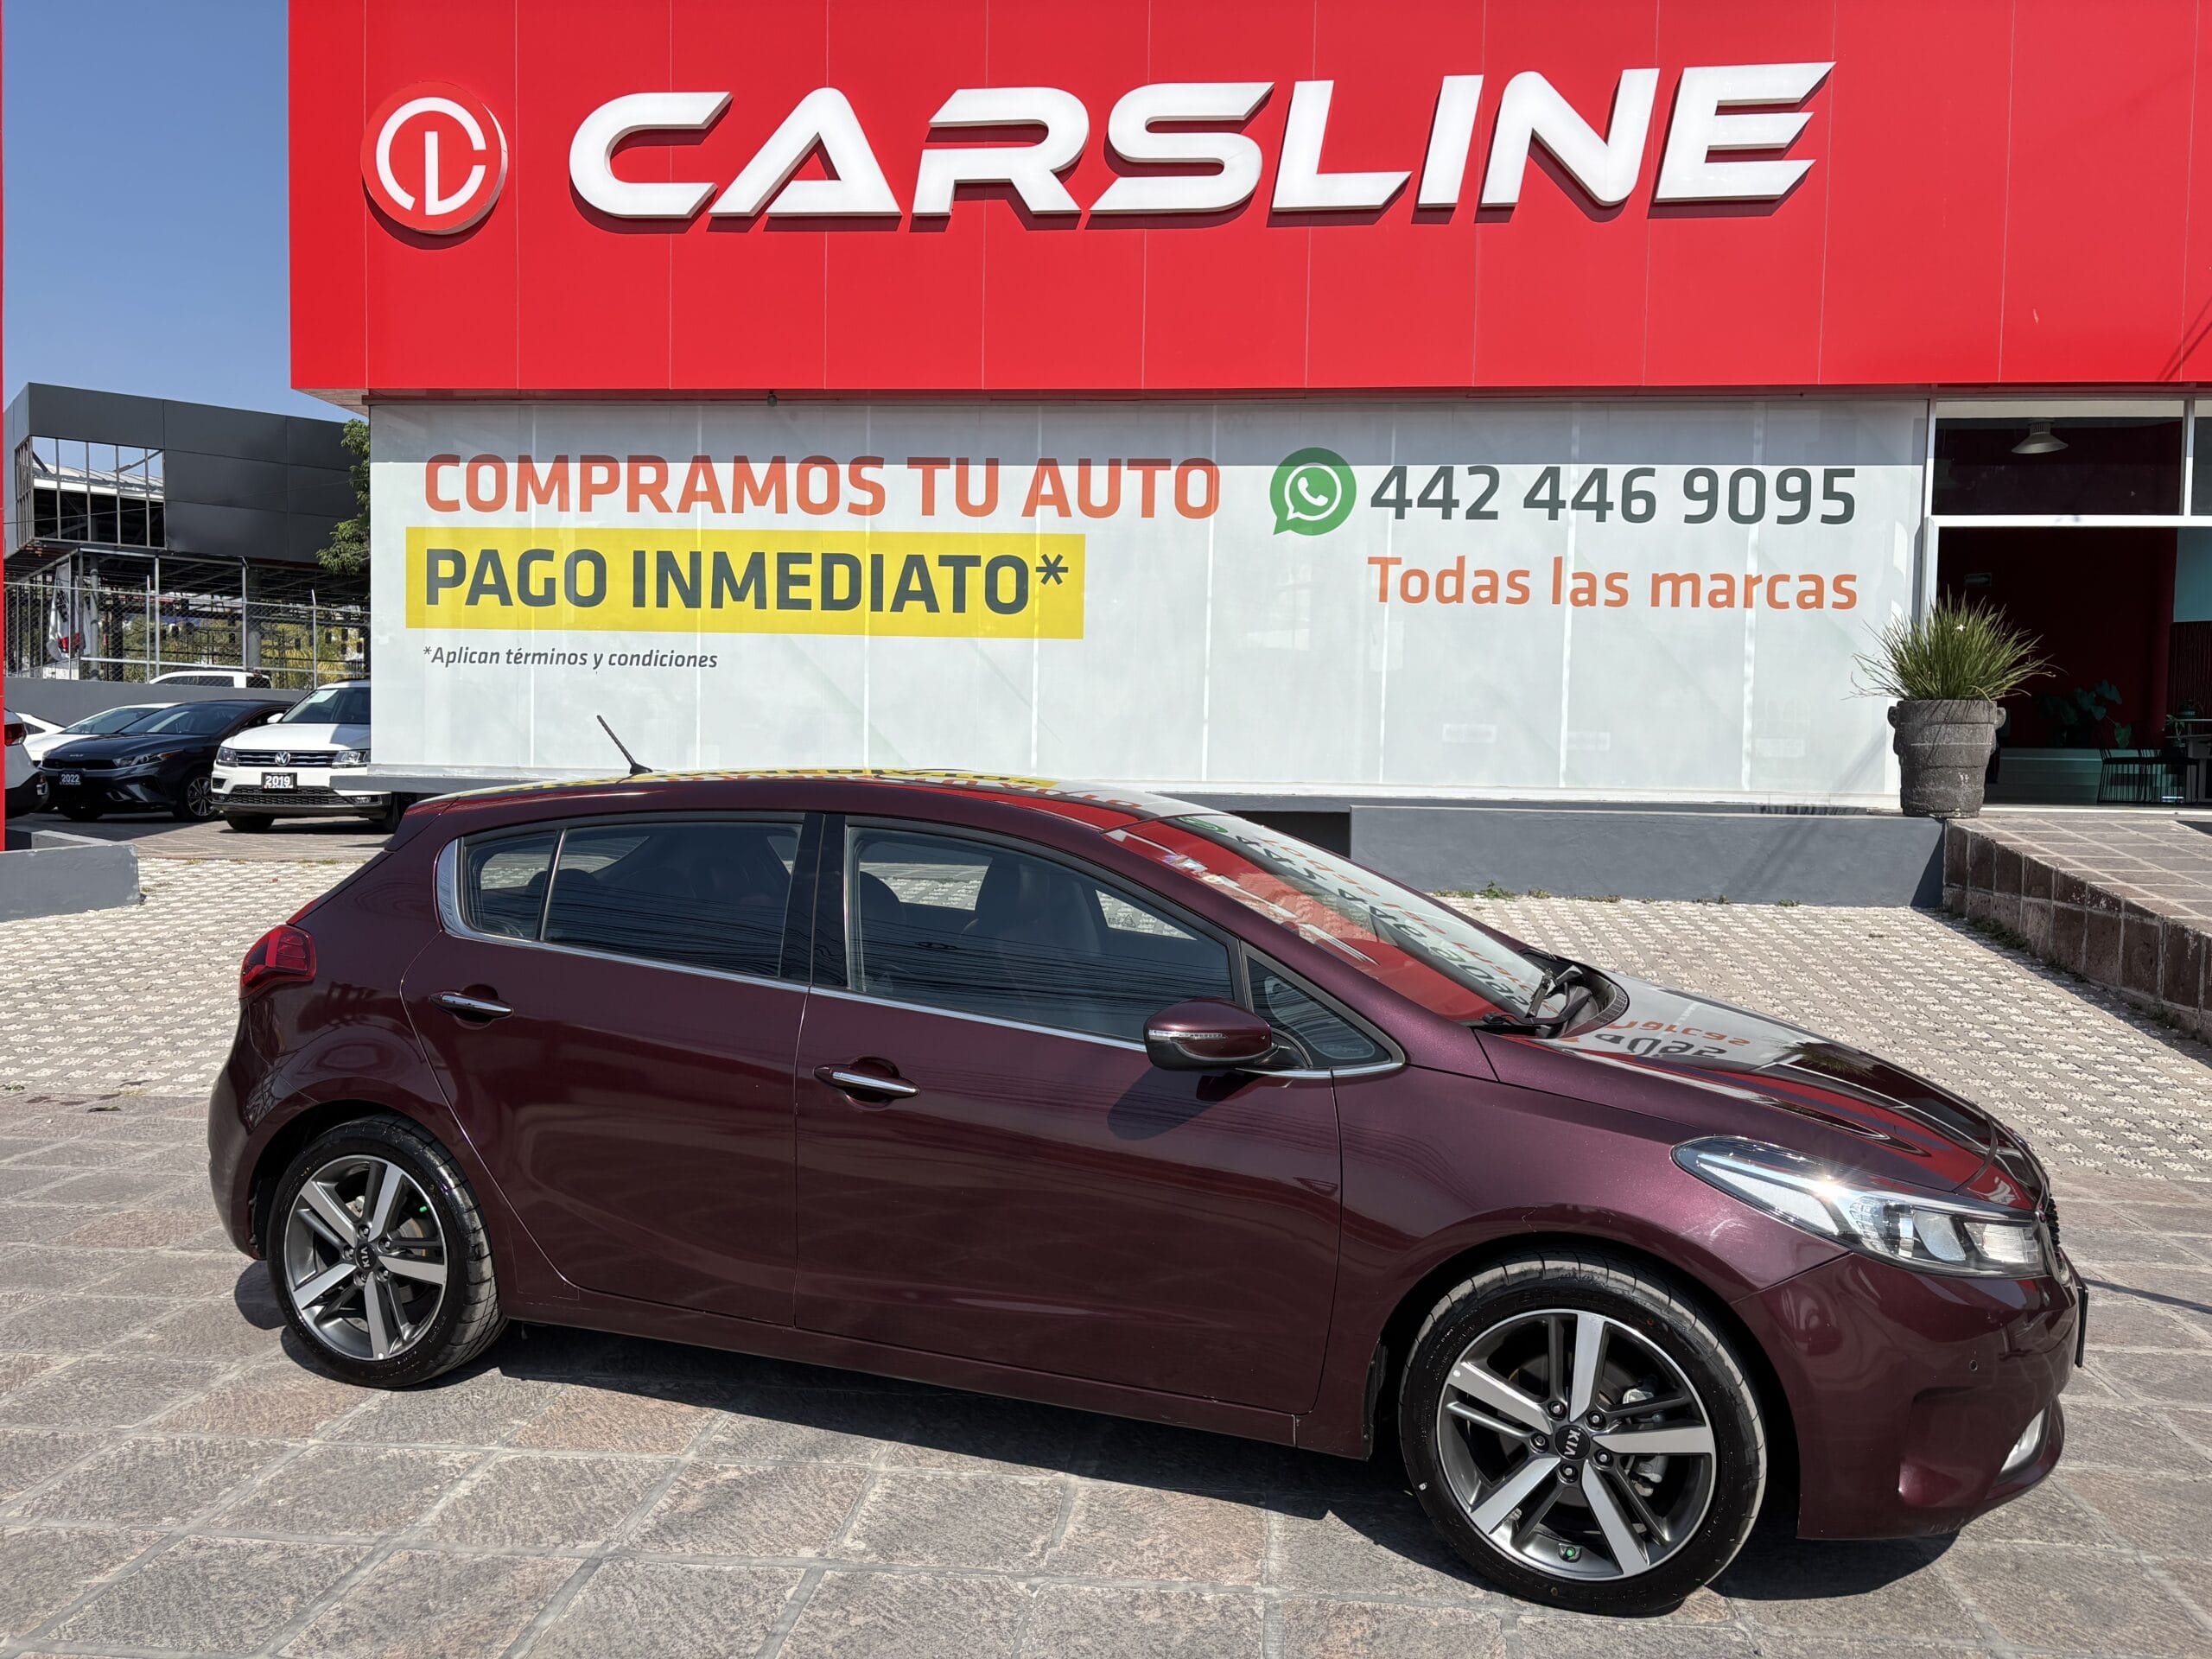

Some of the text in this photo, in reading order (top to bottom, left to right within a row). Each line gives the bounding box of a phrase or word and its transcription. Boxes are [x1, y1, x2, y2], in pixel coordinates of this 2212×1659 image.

[568, 61, 1838, 219] CARSLINE
[424, 454, 1221, 520] COMPRAMOS TU AUTO
[1370, 465, 1856, 525] 442 446 9095
[425, 548, 607, 608] PAGO
[1367, 555, 1858, 610] Todas las marcas
[505, 647, 588, 666] términos
[592, 652, 603, 670] y
[608, 650, 719, 669] condiciones
[61, 773, 80, 783] 2022
[265, 775, 291, 786] 2019
[360, 1246, 371, 1268] KIA
[1564, 1429, 1581, 1455] KIA
